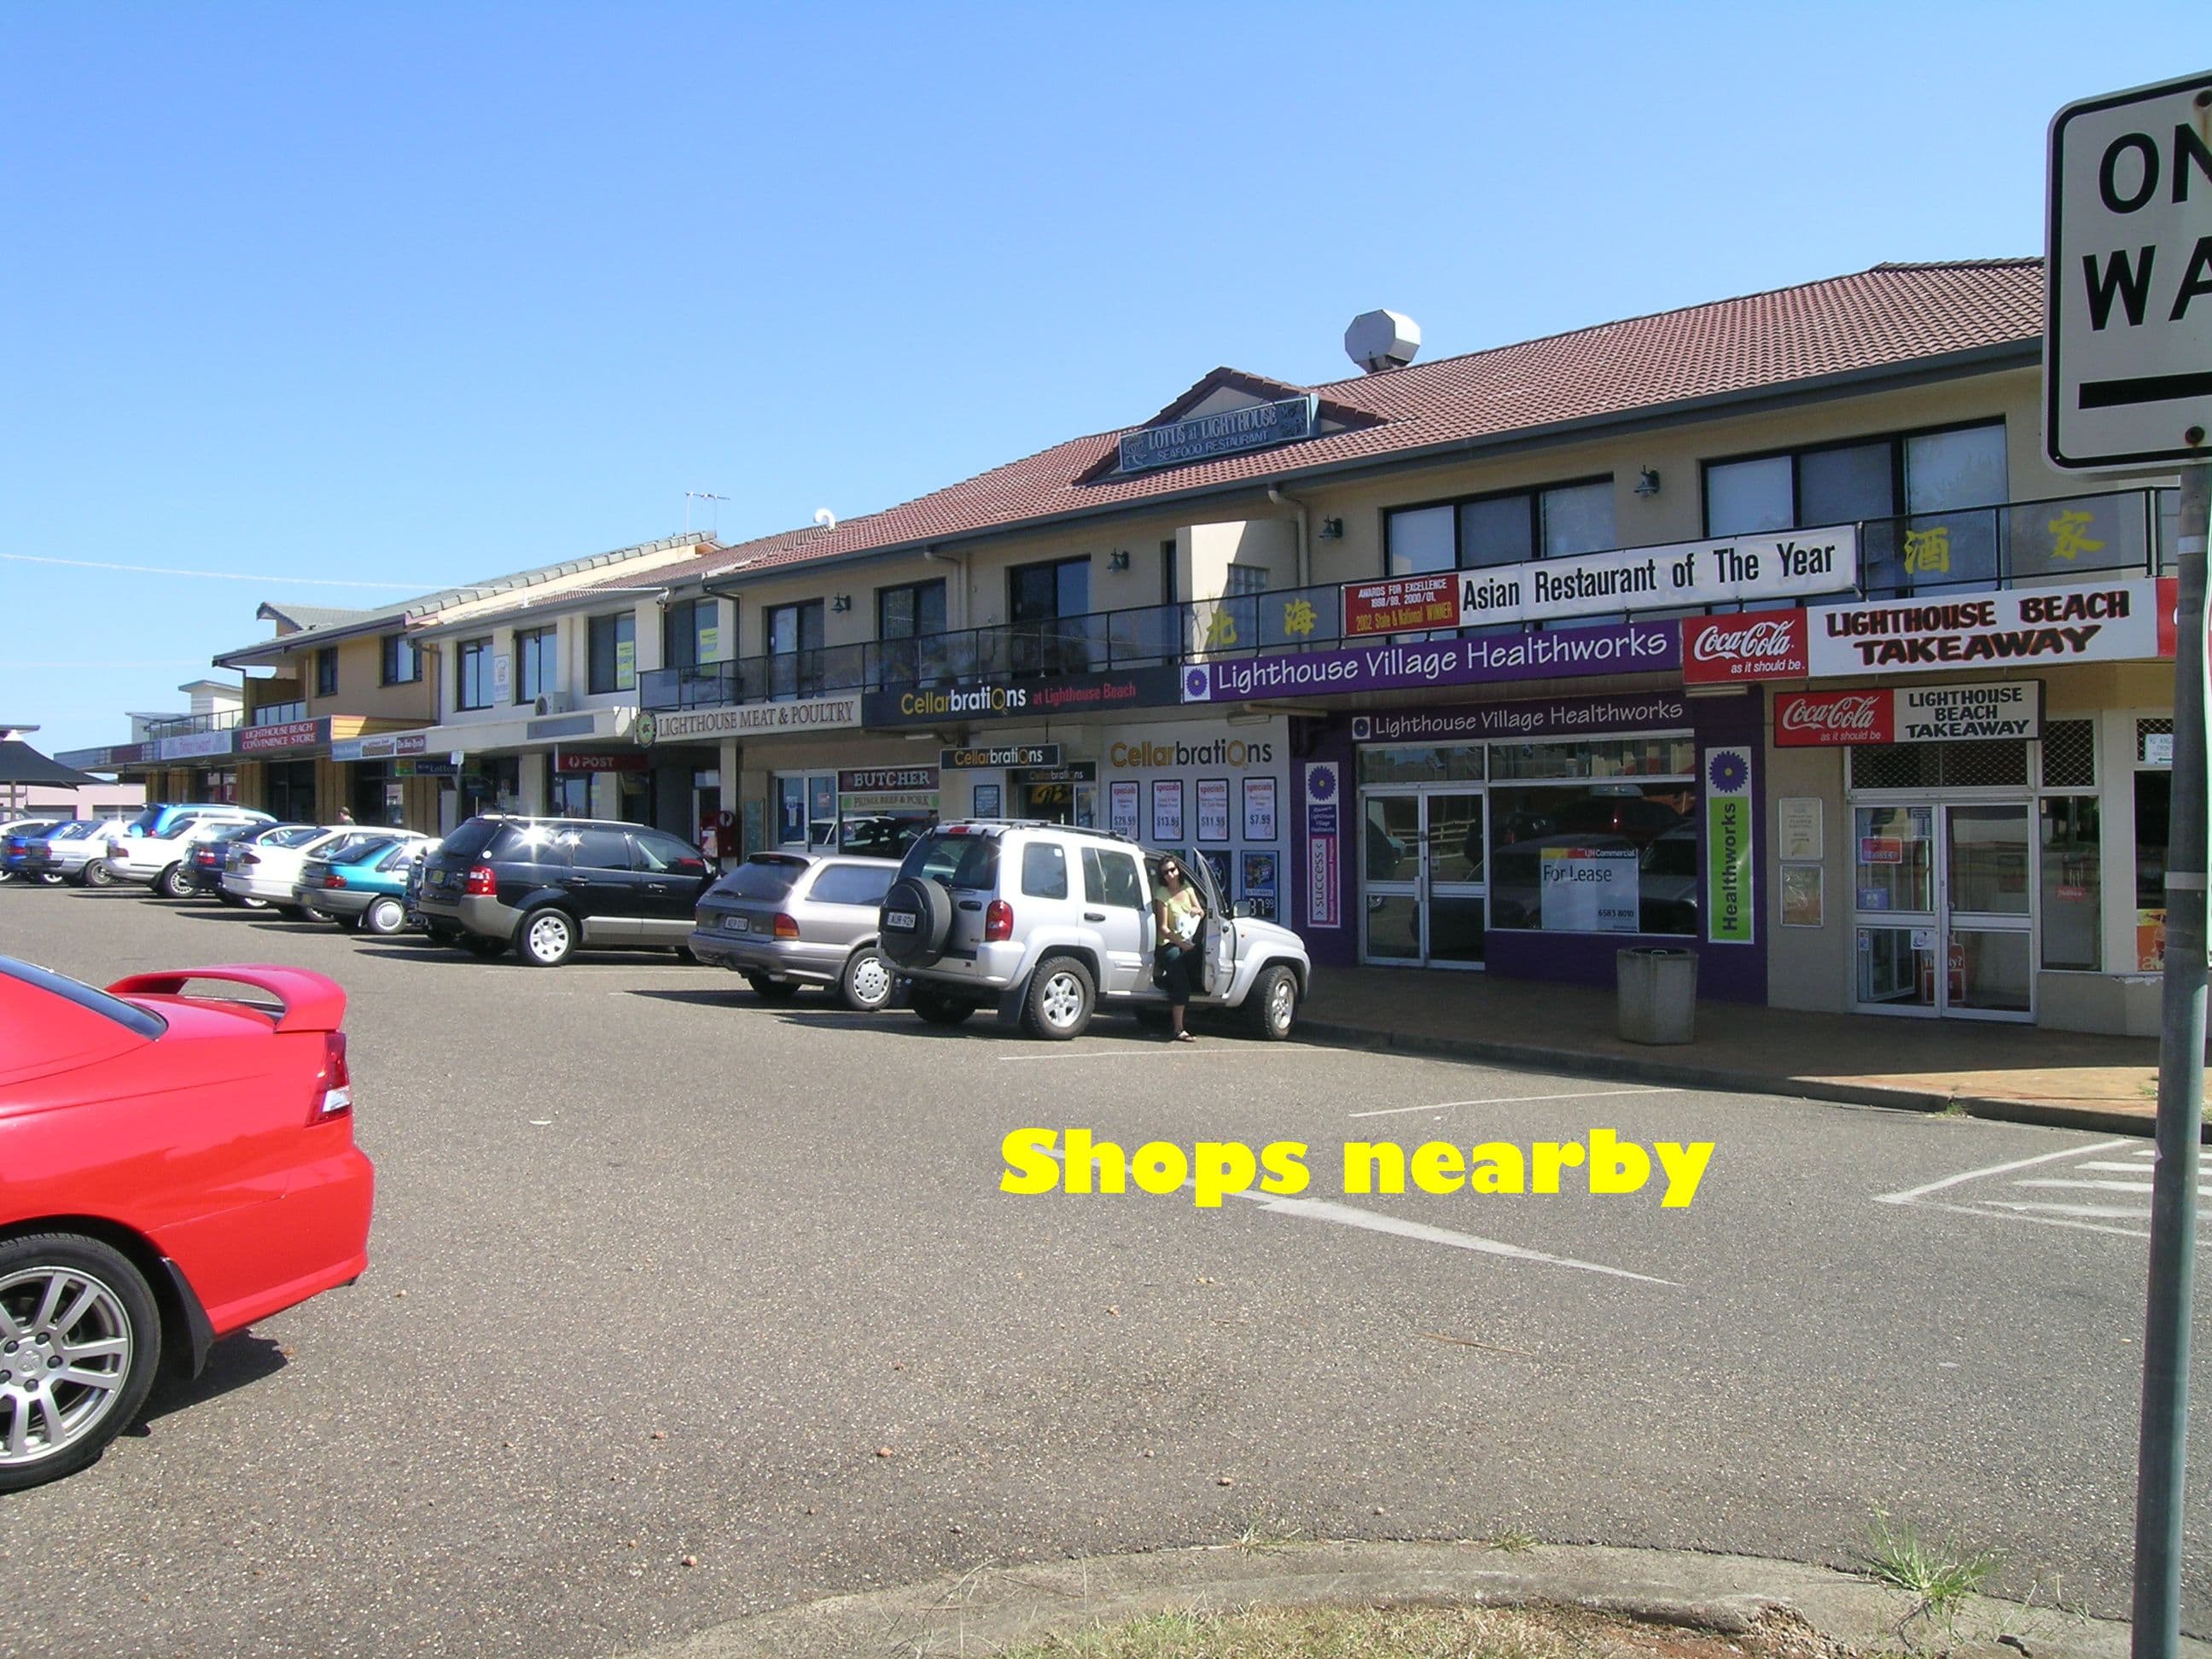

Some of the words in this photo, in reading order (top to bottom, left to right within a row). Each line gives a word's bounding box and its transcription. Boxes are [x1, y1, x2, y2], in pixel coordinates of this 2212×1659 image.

[1149, 426, 1186, 451] LOTUS
[1200, 405, 1278, 439] LIGHTHOUSE
[1157, 444, 1202, 463] SEAFOOD
[1206, 430, 1268, 454] RESTAURANT
[1358, 586, 1386, 598] AWARDS
[1388, 584, 1402, 596] FOR
[1405, 579, 1447, 593] EXCELLENCE
[1463, 579, 1521, 612] Asian
[1535, 558, 1656, 603] Restaurant
[1673, 553, 1695, 589] of
[1714, 547, 1760, 584] The
[1776, 540, 1837, 578] Year
[1356, 614, 1373, 632] 2002
[1375, 612, 1391, 629] State
[1392, 610, 1398, 626] &
[1398, 606, 1423, 625] National
[1426, 601, 1453, 621] WINNER
[1825, 600, 1996, 638] LIGHTHOUSE
[2018, 590, 2131, 626] BEACH
[1693, 620, 1796, 661] Coca-Cola
[1853, 624, 2103, 667] TAKEAWAY
[1219, 658, 1359, 694] Lighthouse
[1365, 648, 1457, 680] Village
[1467, 628, 1668, 670] Healthworks
[1731, 663, 1743, 673] as
[1744, 661, 1751, 673] it
[1753, 659, 1785, 672] should
[900, 685, 1027, 716] Cellarbrations
[1045, 687, 1100, 707] Lighthouse
[1103, 682, 1137, 700] Beach
[1908, 687, 2023, 708] LIGHTHOUSE
[658, 711, 737, 737] LIGHTHOUSE
[740, 708, 776, 727] MEAT
[777, 707, 788, 724] &
[791, 701, 853, 724] POULTRY
[1376, 714, 1476, 737] Lighthouse
[1481, 708, 1544, 731] Village
[1550, 700, 1683, 725] Healthworks
[1782, 696, 1880, 731] Coca-Cola
[1905, 719, 2030, 739] TAKEAWAY
[1934, 705, 1998, 722] BEACH
[242, 735, 288, 750] CONVENIENCE
[290, 732, 317, 746] STORE
[245, 725, 288, 740] LIGHTHOUSE
[288, 723, 314, 735] BEACH
[1820, 733, 1831, 742] as
[1832, 731, 1838, 742] it
[1840, 731, 1868, 742] should
[582, 756, 614, 767] POST
[954, 748, 1044, 766] Cellarbrations
[1110, 739, 1272, 770] Cellarbrations
[853, 770, 930, 787] BUTCHER
[906, 795, 928, 806] PORK
[1315, 853, 1324, 908] success
[1543, 864, 1566, 882] For
[1570, 864, 1612, 882] Lease
[1721, 802, 1738, 931] Healthworks
[1598, 909, 1615, 918] 6583
[1617, 909, 1634, 918] 8010
